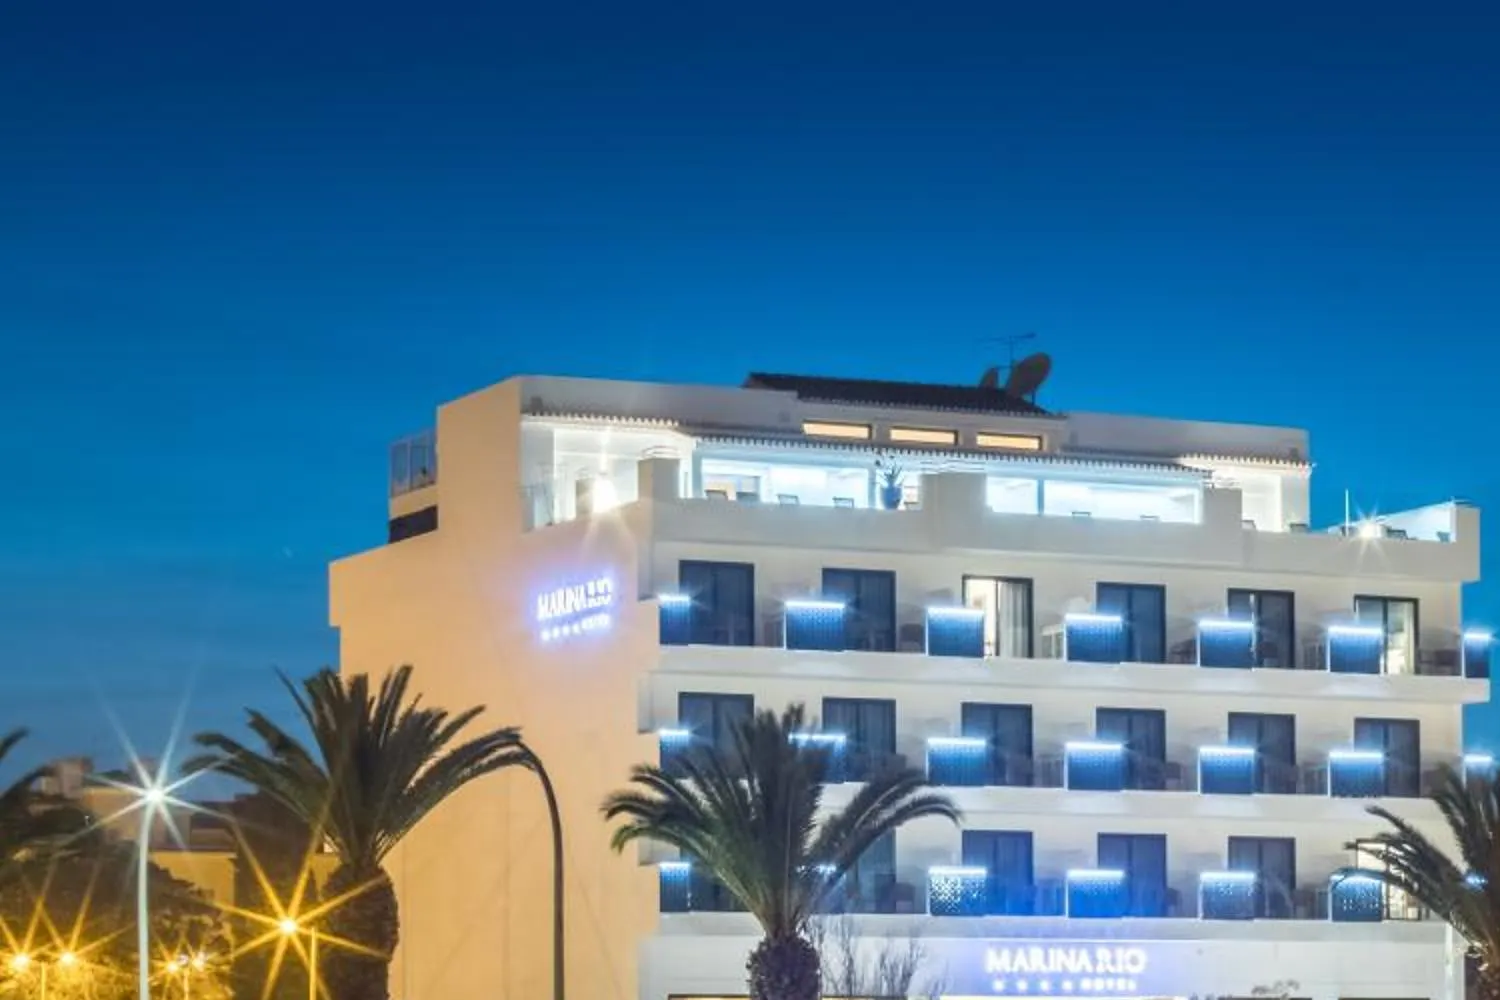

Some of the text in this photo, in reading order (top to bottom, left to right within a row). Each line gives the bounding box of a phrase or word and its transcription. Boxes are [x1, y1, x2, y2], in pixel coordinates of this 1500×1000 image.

[537, 584, 587, 619] MARINA
[986, 947, 1146, 974] MARINA RIO
